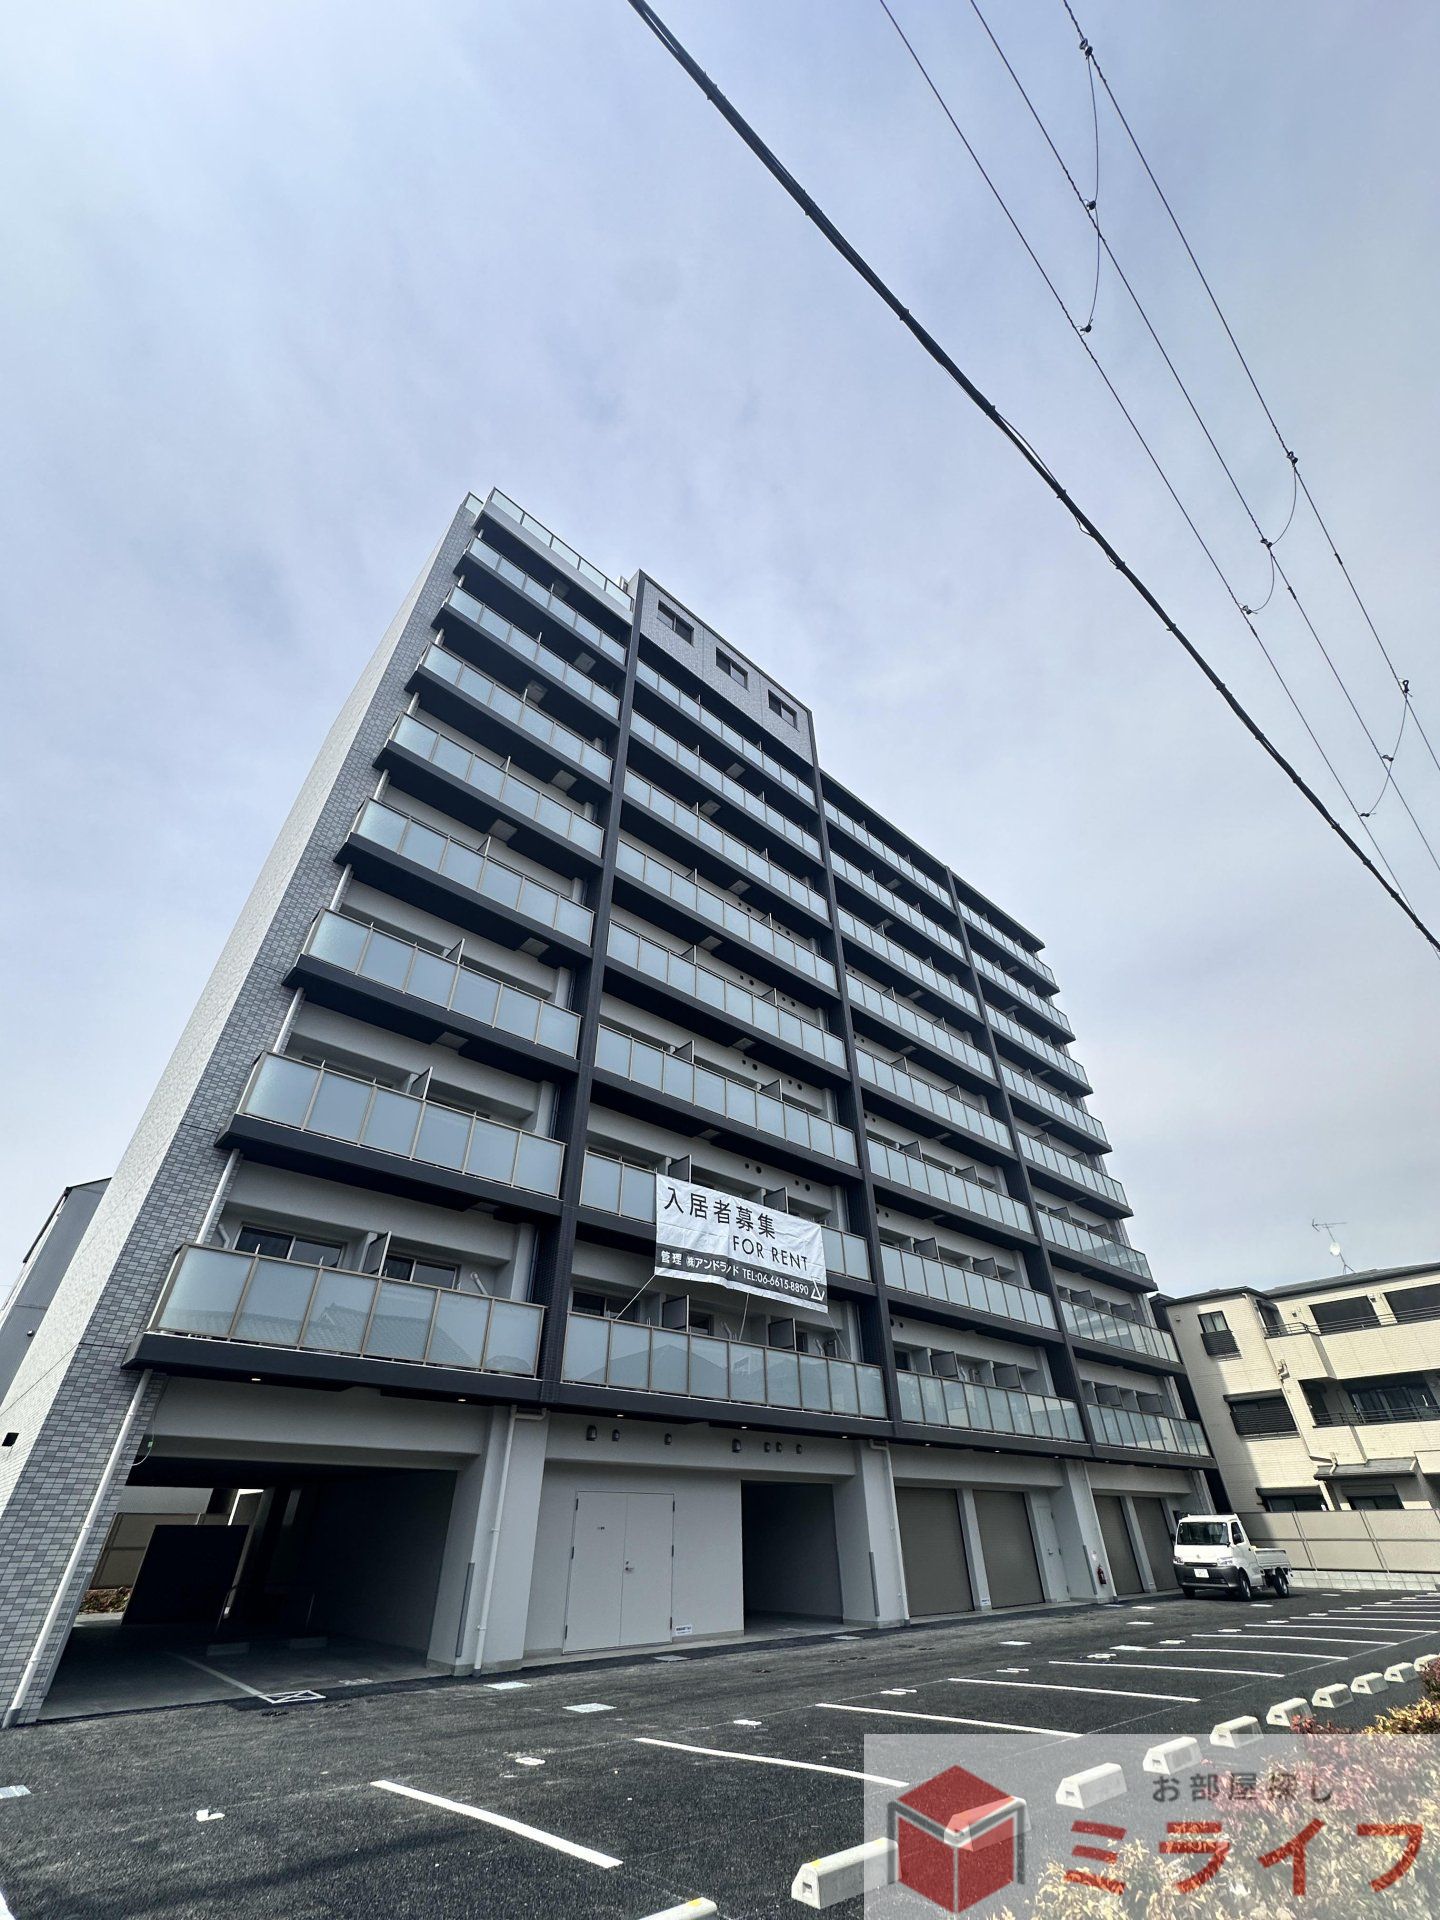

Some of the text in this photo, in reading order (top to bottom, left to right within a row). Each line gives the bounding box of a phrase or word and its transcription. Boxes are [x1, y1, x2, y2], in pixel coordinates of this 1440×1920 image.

[664, 1187, 776, 1240] 入居者募集
[661, 1250, 682, 1266] 管理
[733, 1235, 808, 1271] FOR RENT
